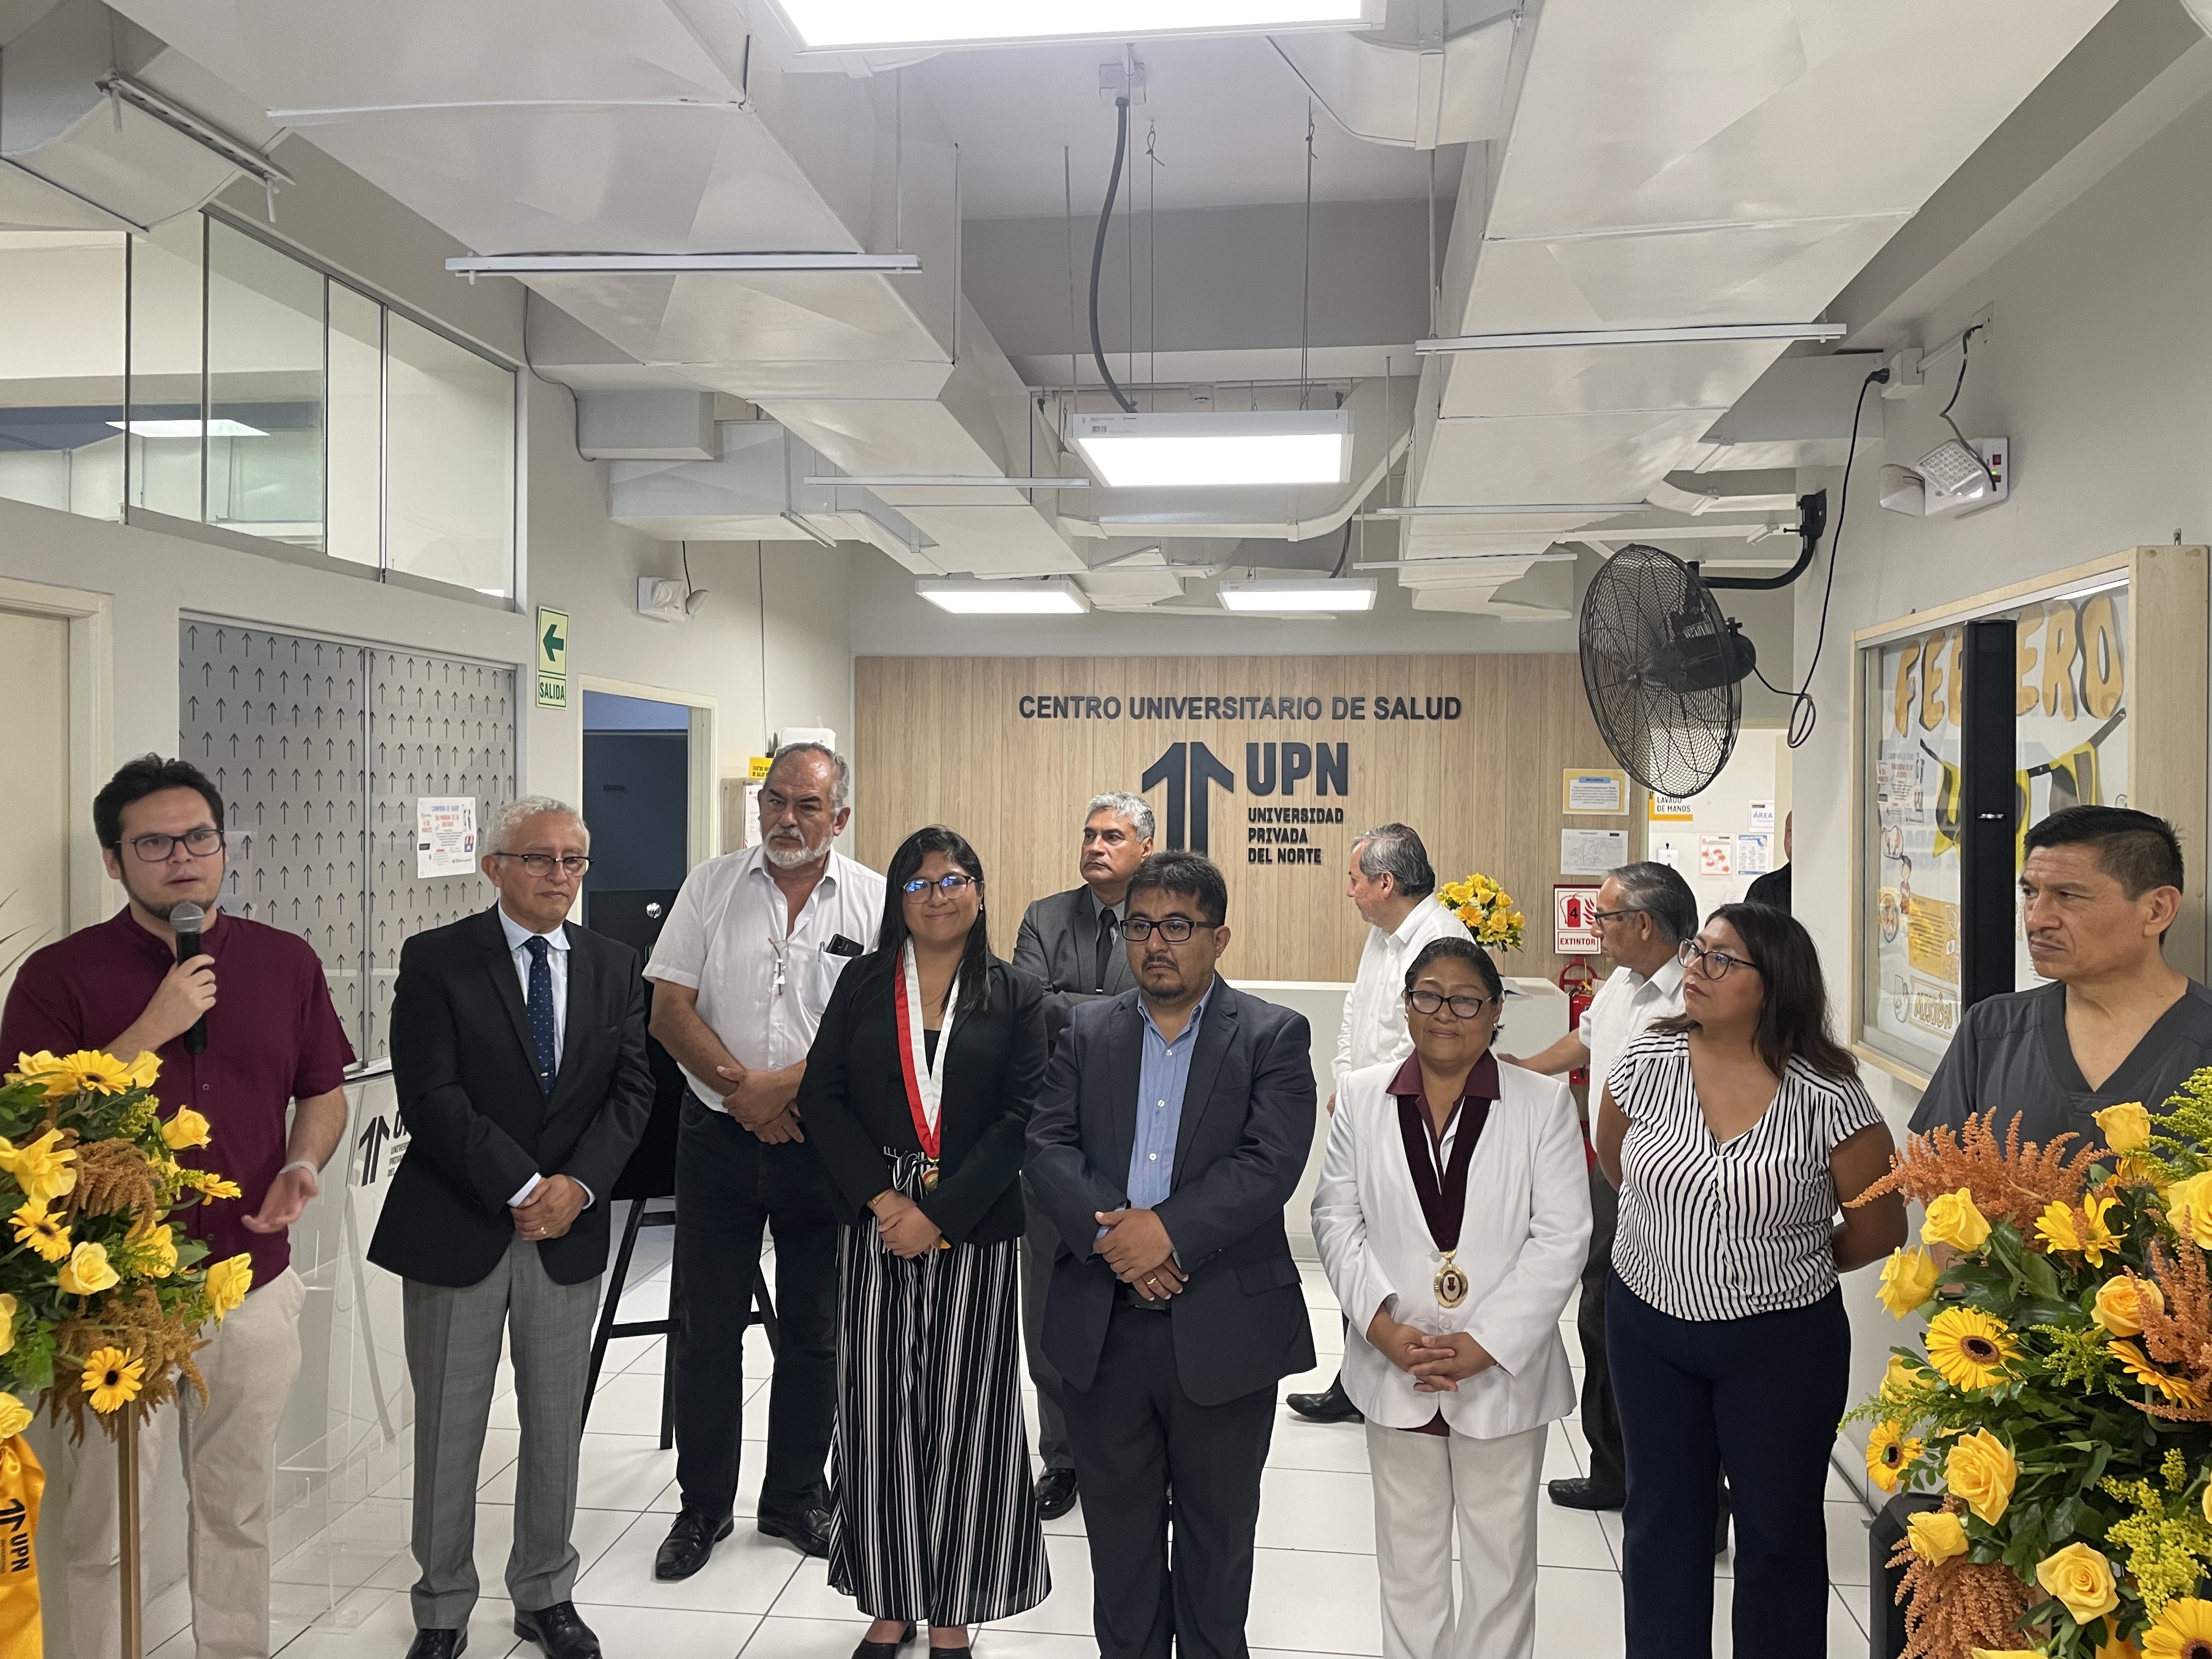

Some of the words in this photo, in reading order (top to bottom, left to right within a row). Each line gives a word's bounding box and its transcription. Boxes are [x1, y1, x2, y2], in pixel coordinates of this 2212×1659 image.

[1894, 594, 2124, 738] FEERO
[540, 682, 565, 701] SALIDA
[1019, 695, 1121, 719] CENTRO
[1130, 696, 1322, 720] UNIVERSITARIO
[1331, 697, 1365, 720] DE
[1373, 696, 1462, 720] SALUD
[1246, 742, 1348, 796] UPN
[1248, 807, 1344, 824] UNIVERSIDAD
[1248, 827, 1308, 844] PRIVADA
[1248, 848, 1273, 865] DEL
[1277, 848, 1321, 865] NORTE
[1570, 906, 1578, 919] 4
[10, 1532, 30, 1573] UPN
